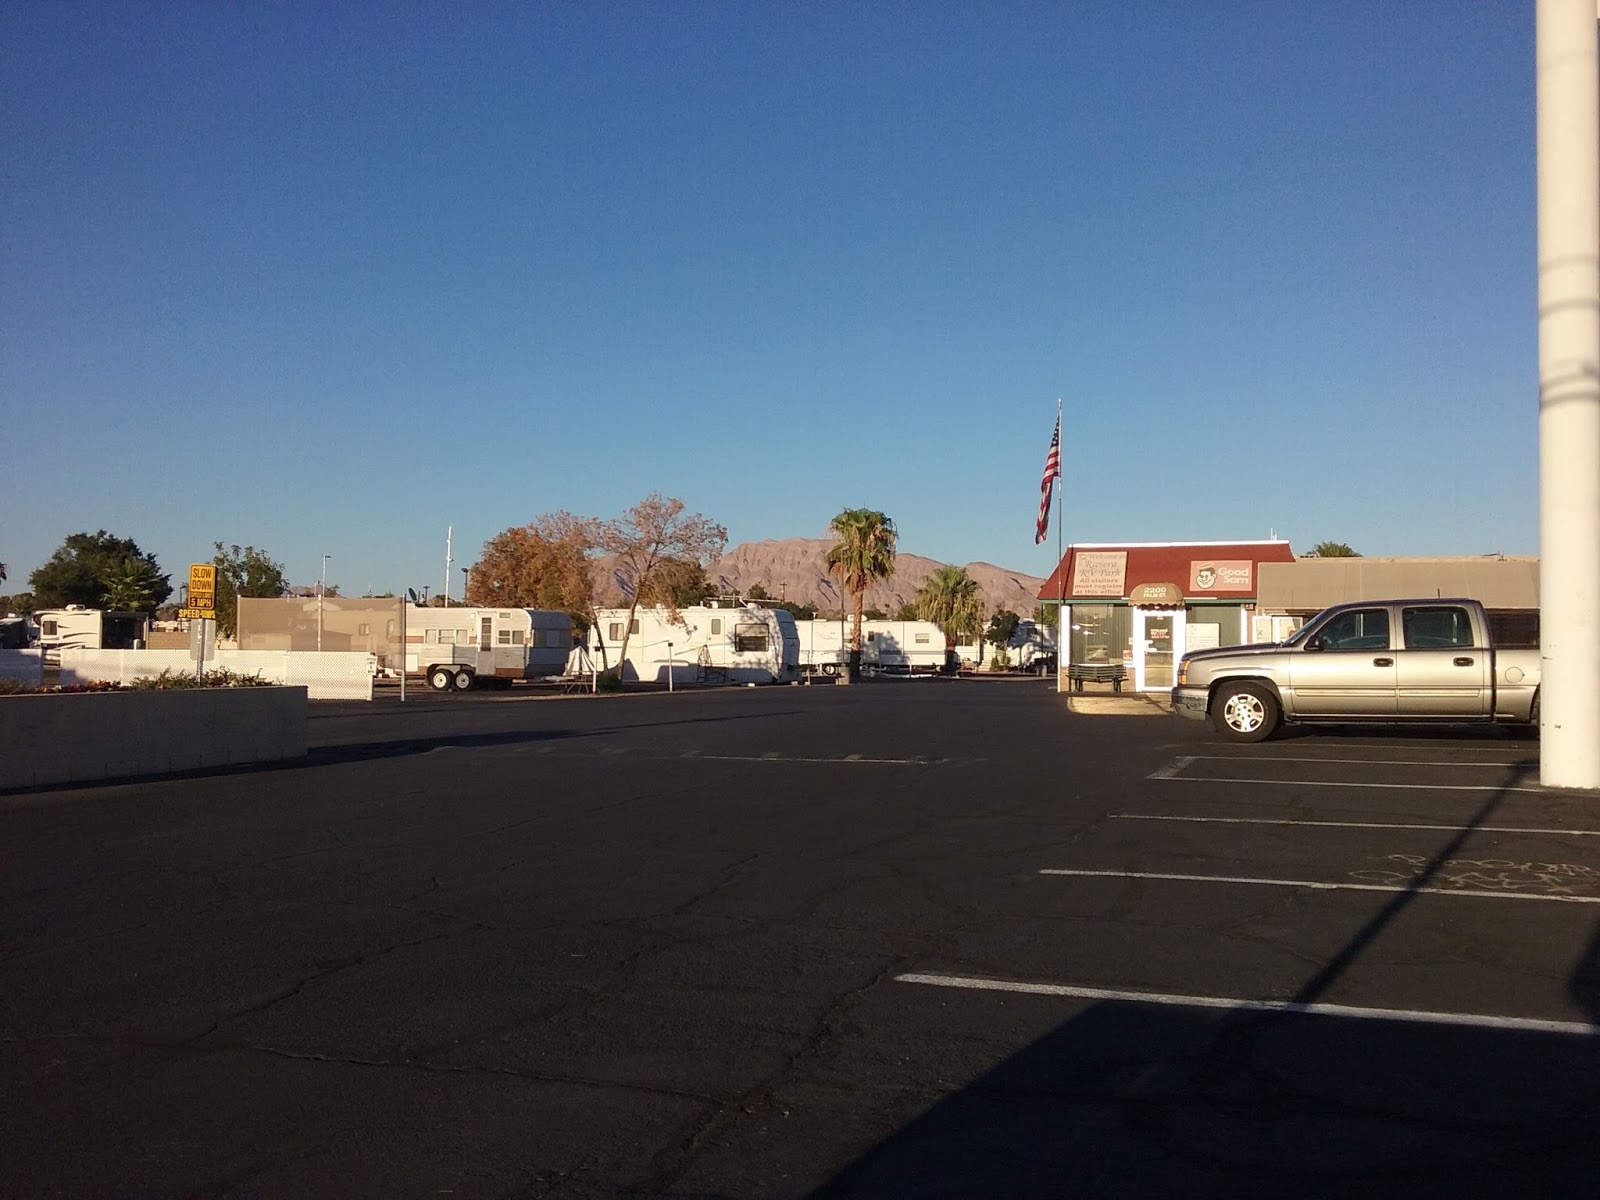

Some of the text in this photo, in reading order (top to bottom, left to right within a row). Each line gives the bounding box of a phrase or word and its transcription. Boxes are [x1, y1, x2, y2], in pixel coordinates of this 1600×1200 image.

[1085, 560, 1118, 570] Riviera
[192, 568, 212, 578] SLOW
[1079, 568, 1121, 578] RV Park
[1218, 567, 1249, 576] Good
[1223, 575, 1249, 584] Sam
[192, 580, 212, 590] DOWN
[191, 598, 212, 607] 5 MPH
